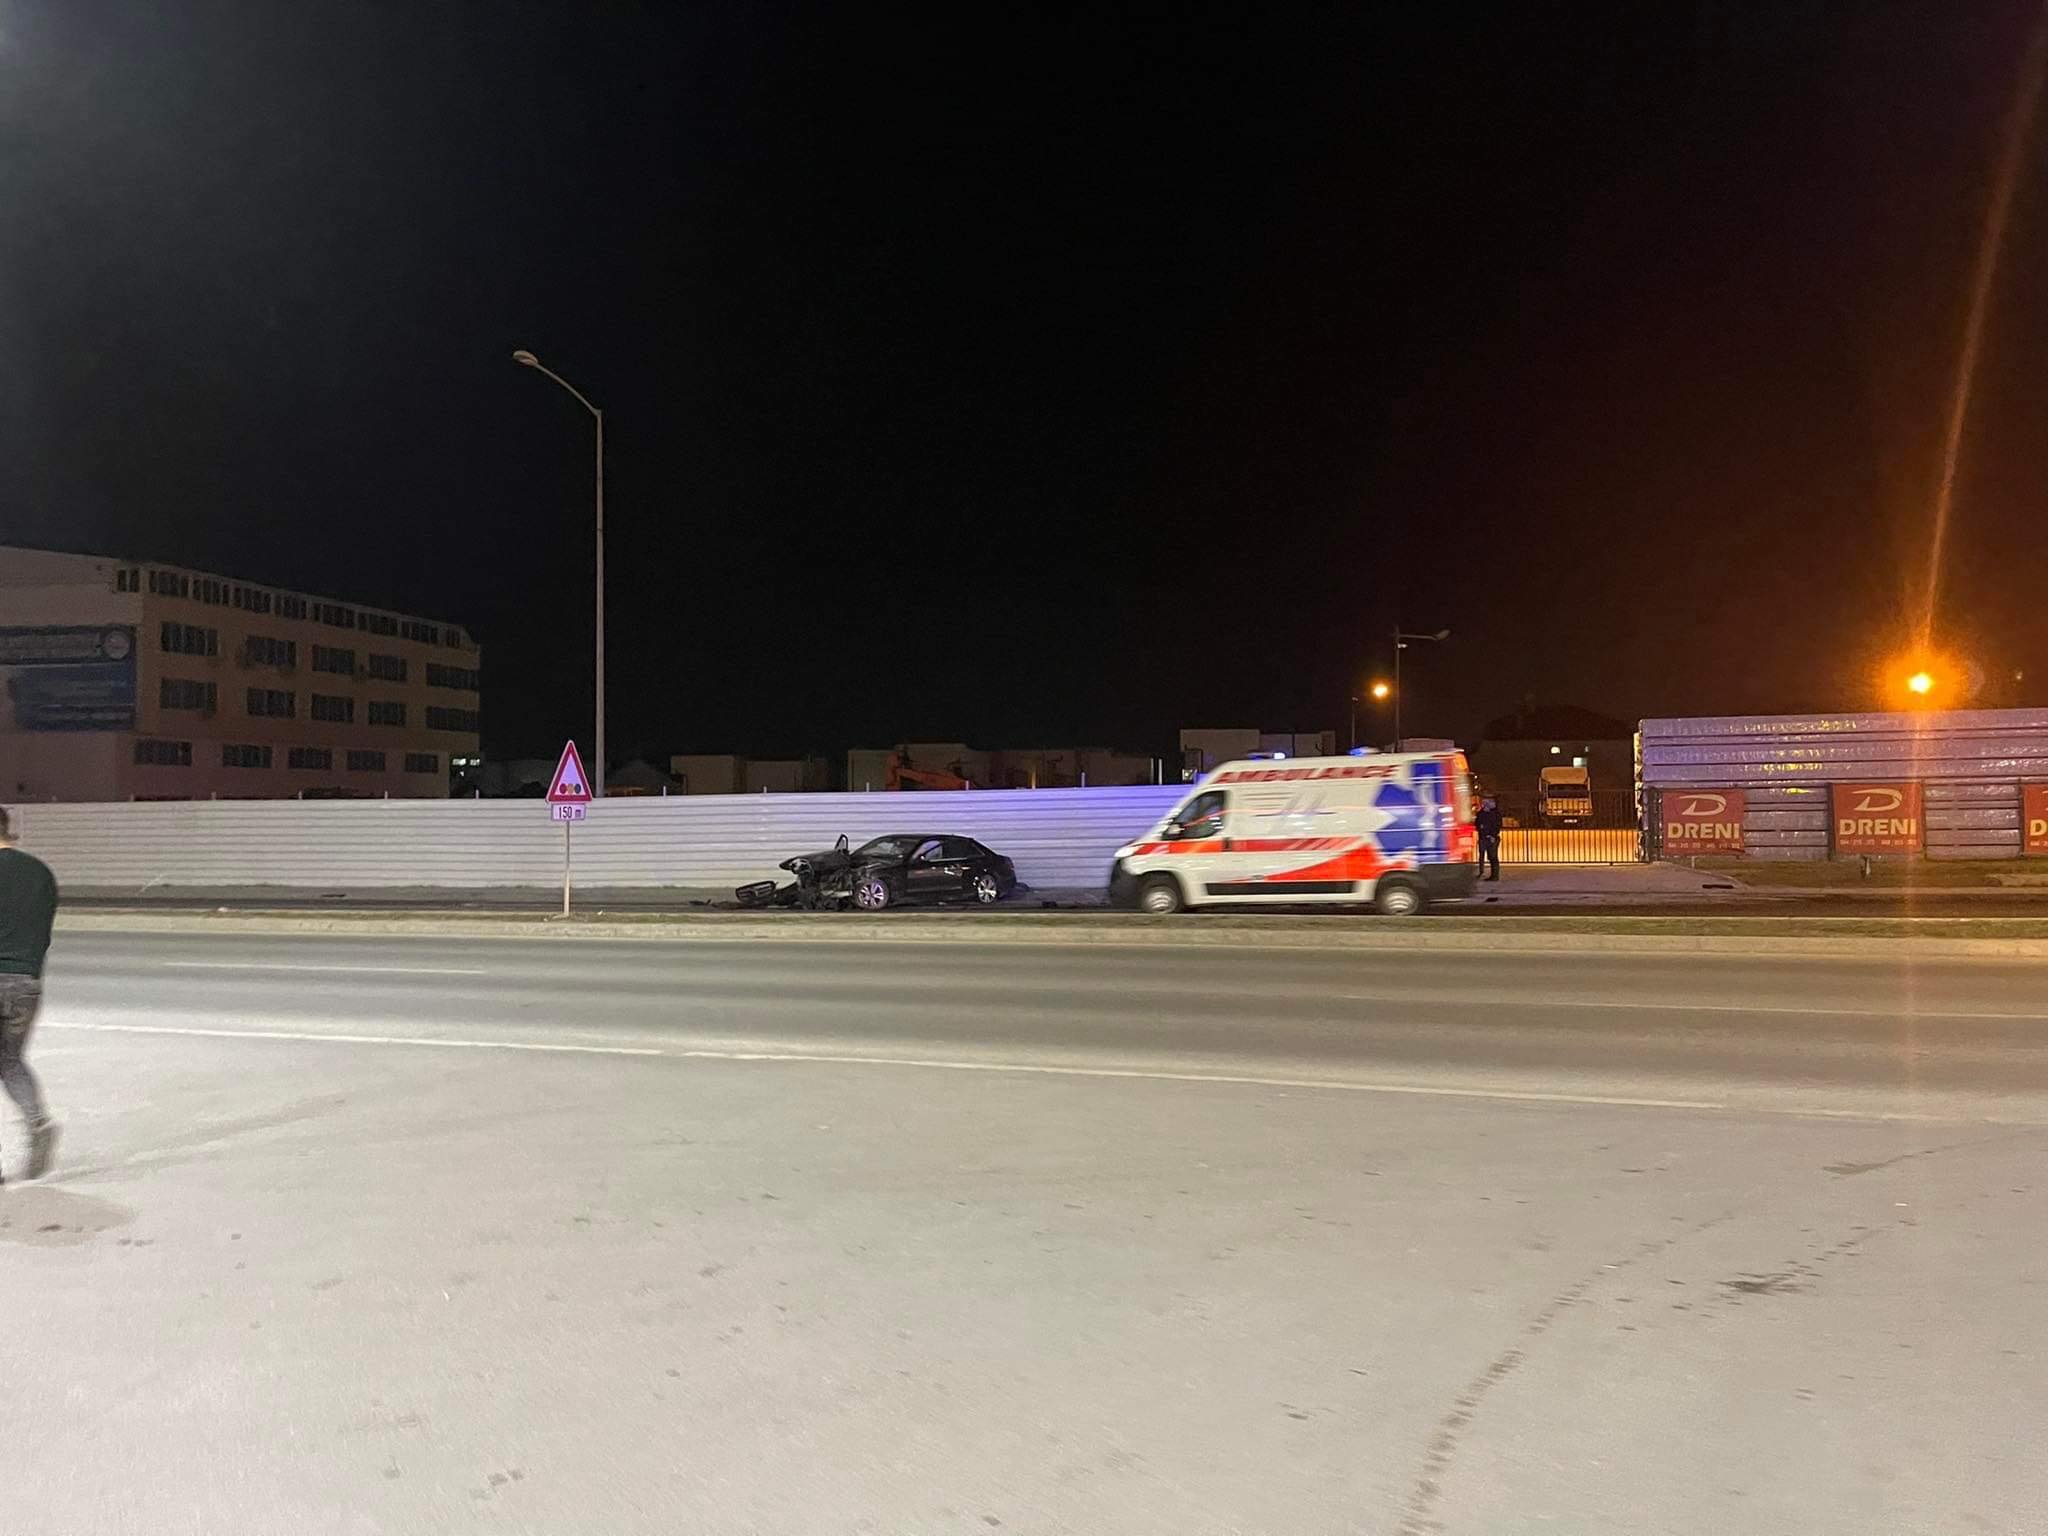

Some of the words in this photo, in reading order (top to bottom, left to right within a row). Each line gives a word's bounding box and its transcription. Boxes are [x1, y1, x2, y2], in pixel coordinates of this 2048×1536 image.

[1213, 764, 1402, 784] AMBULANCE
[559, 806, 573, 819] 150
[1668, 823, 1740, 840] DRENI
[1840, 819, 1917, 836] DRENI
